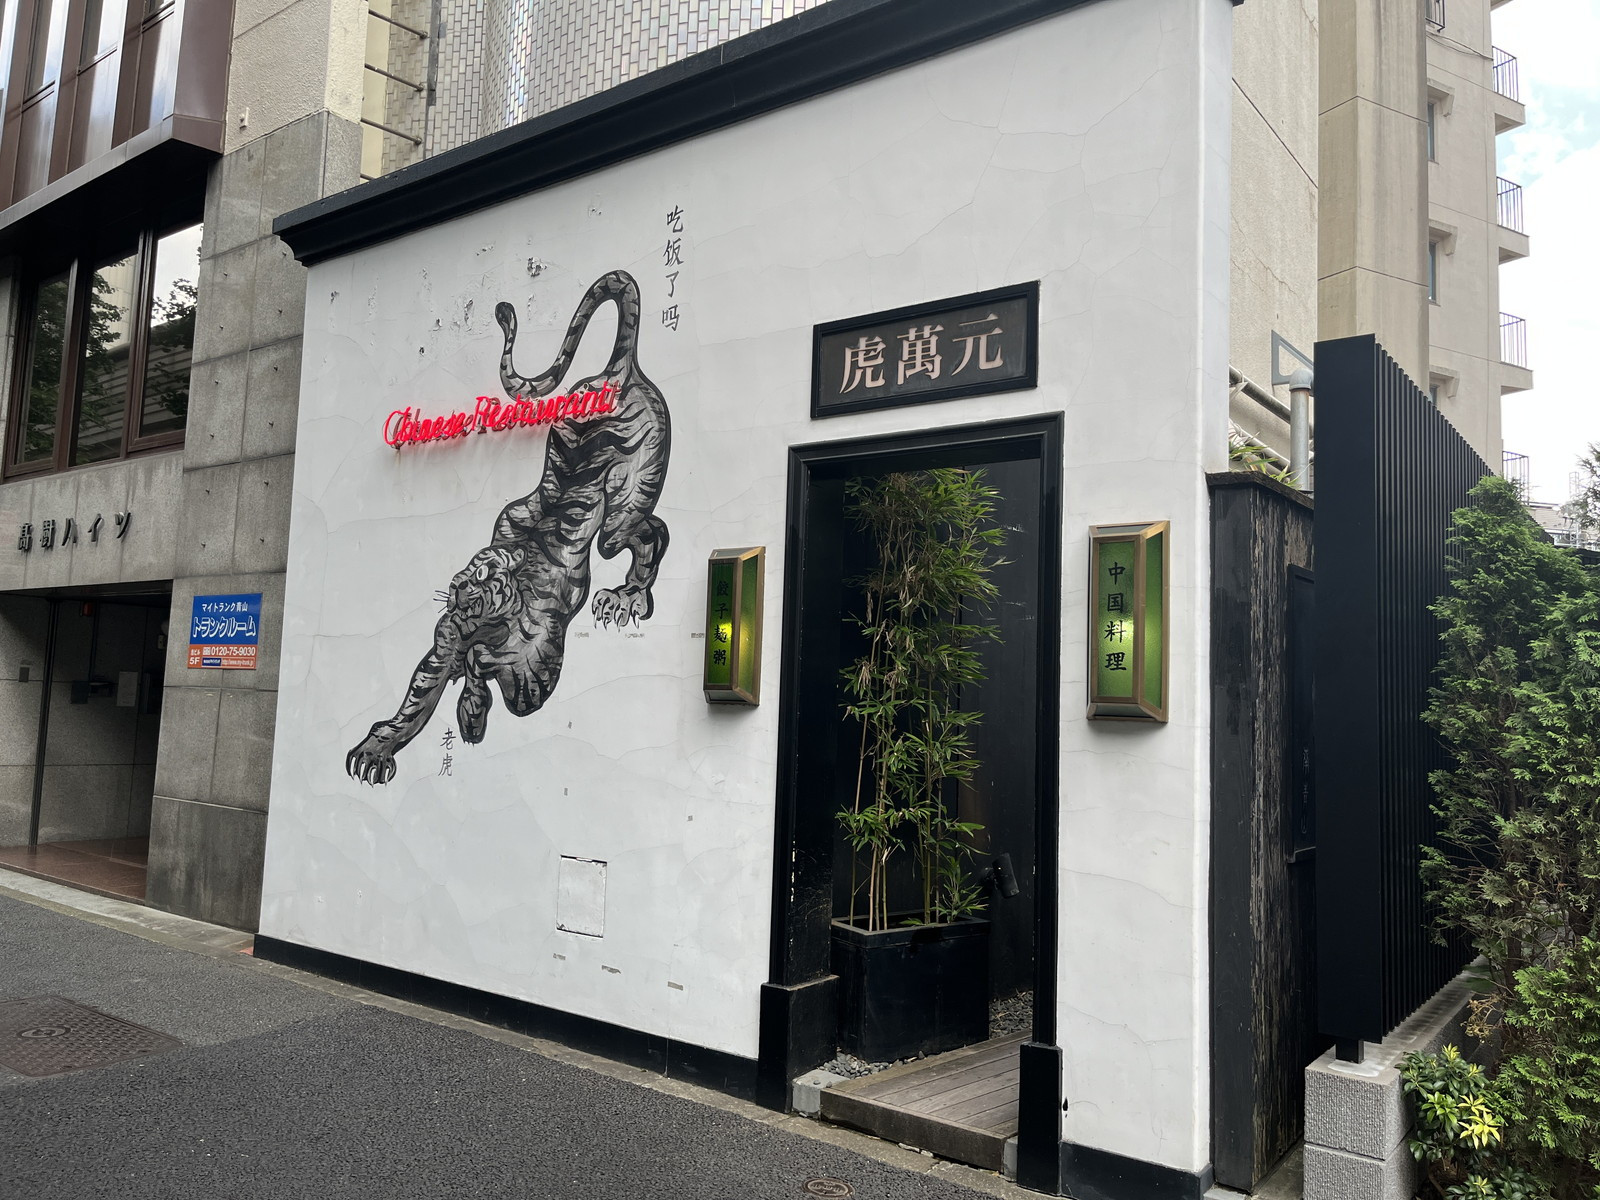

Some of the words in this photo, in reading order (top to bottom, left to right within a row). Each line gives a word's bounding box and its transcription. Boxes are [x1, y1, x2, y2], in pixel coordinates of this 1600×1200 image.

[662, 205, 684, 331] 吃饭了吗
[839, 313, 1004, 394] 虎萬元
[384, 406, 472, 447] Chinese
[472, 381, 621, 434] Restaurant
[193, 615, 256, 638] トランクルーム
[201, 601, 248, 612] マイトランク青山
[1104, 562, 1127, 671] 中国料理
[189, 656, 200, 665] 5F
[211, 646, 256, 656] 0120-75-9030
[439, 727, 456, 776] 老虎
